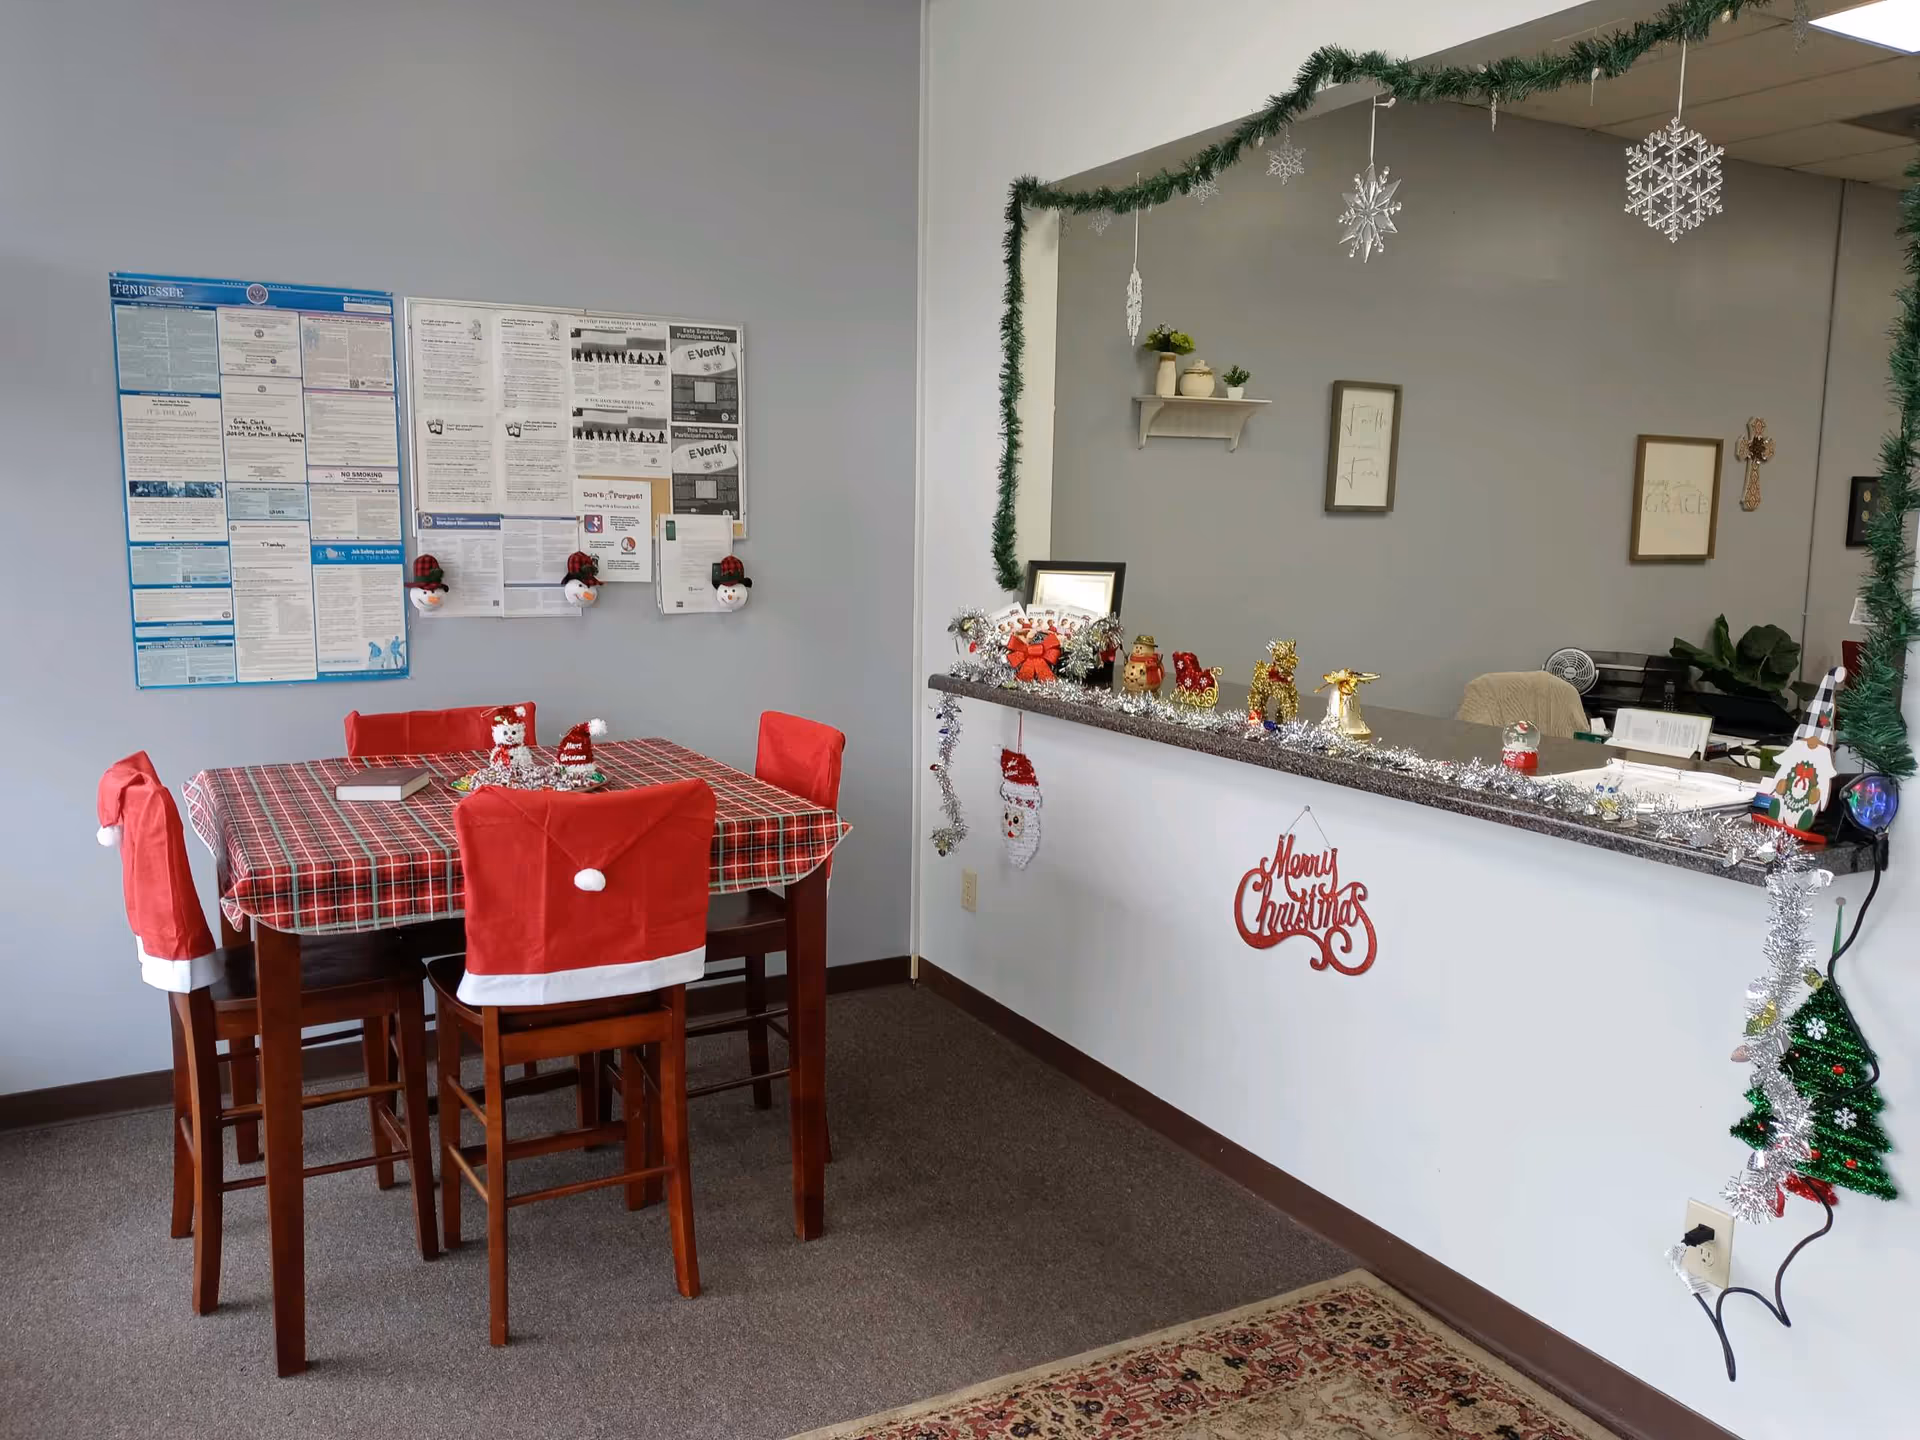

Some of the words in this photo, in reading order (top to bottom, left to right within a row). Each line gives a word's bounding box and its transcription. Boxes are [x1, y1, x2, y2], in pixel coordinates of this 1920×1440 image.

[112, 283, 184, 298] TENNESSEE
[687, 345, 726, 360] E-Verify
[689, 443, 727, 459] E-Verify
[1234, 868, 1378, 977] Christmas
